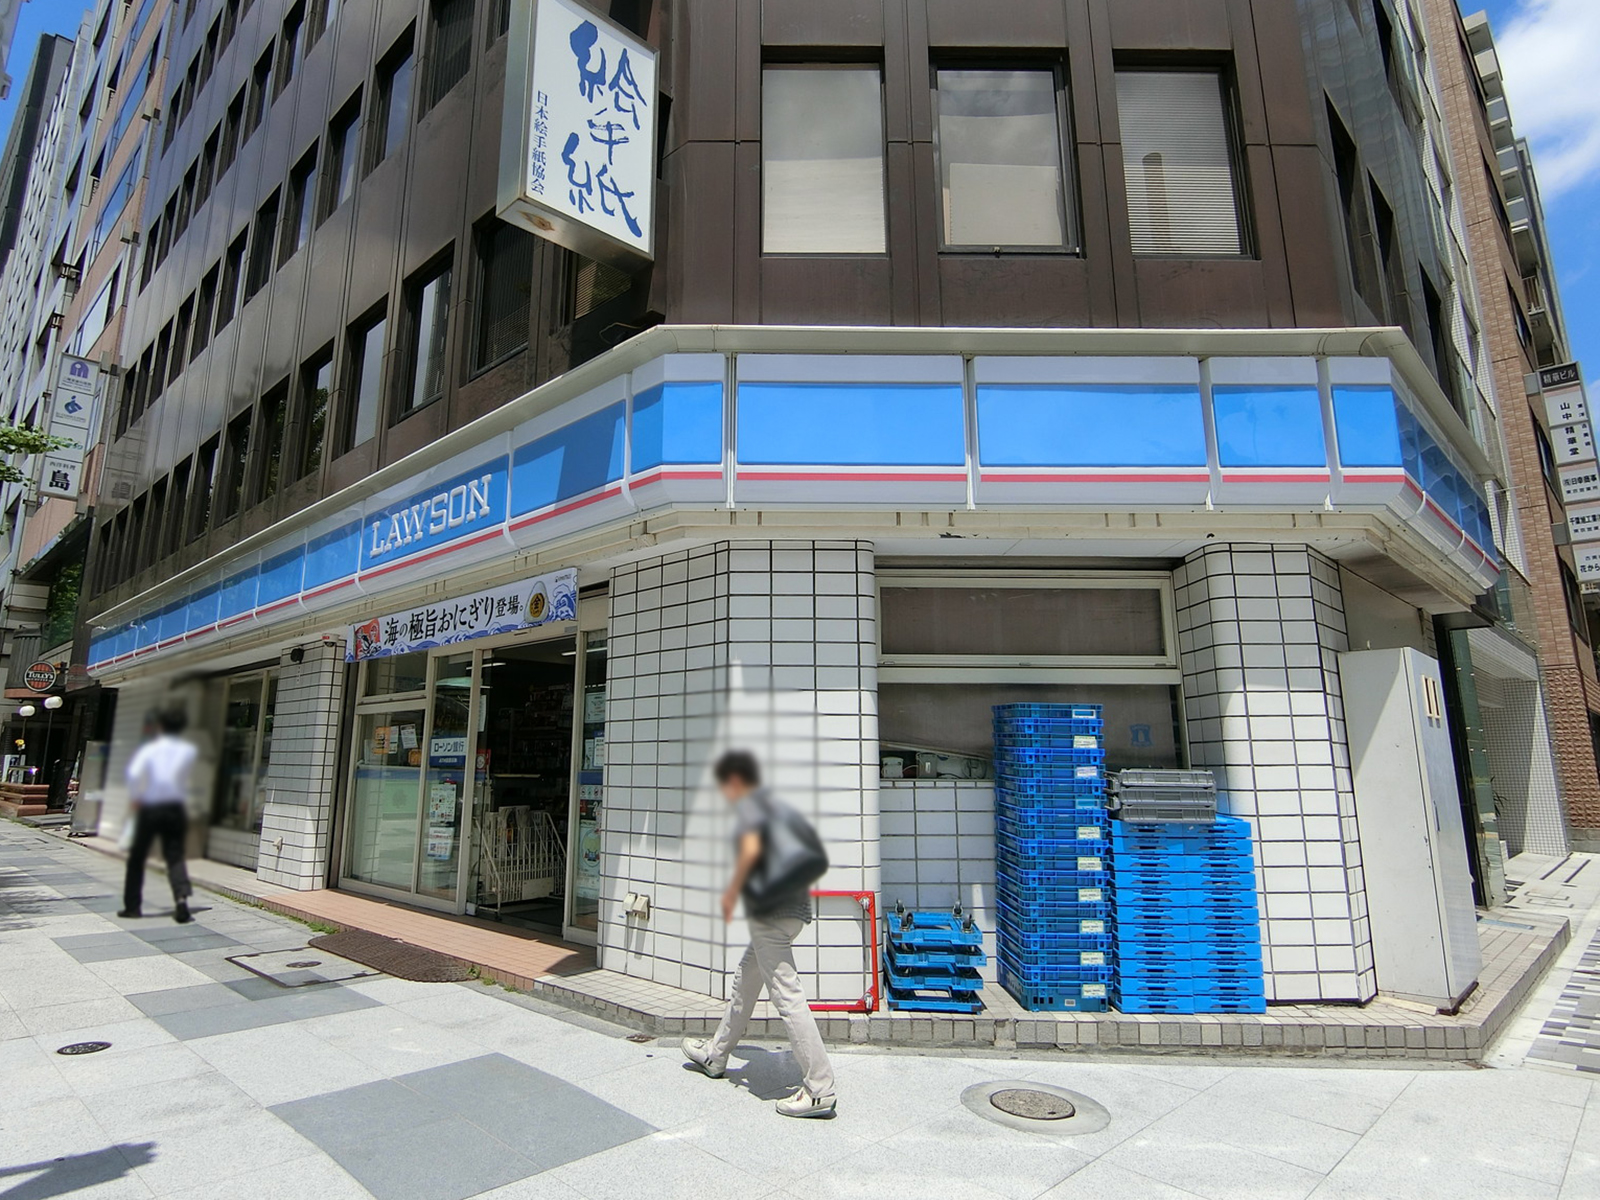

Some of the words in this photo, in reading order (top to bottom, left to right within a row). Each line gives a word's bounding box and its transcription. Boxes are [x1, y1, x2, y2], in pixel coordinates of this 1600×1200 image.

[530, 89, 549, 195] 日本絵手紙協会
[370, 473, 492, 558] LAWSON
[434, 741, 465, 753] ローソン銀行
